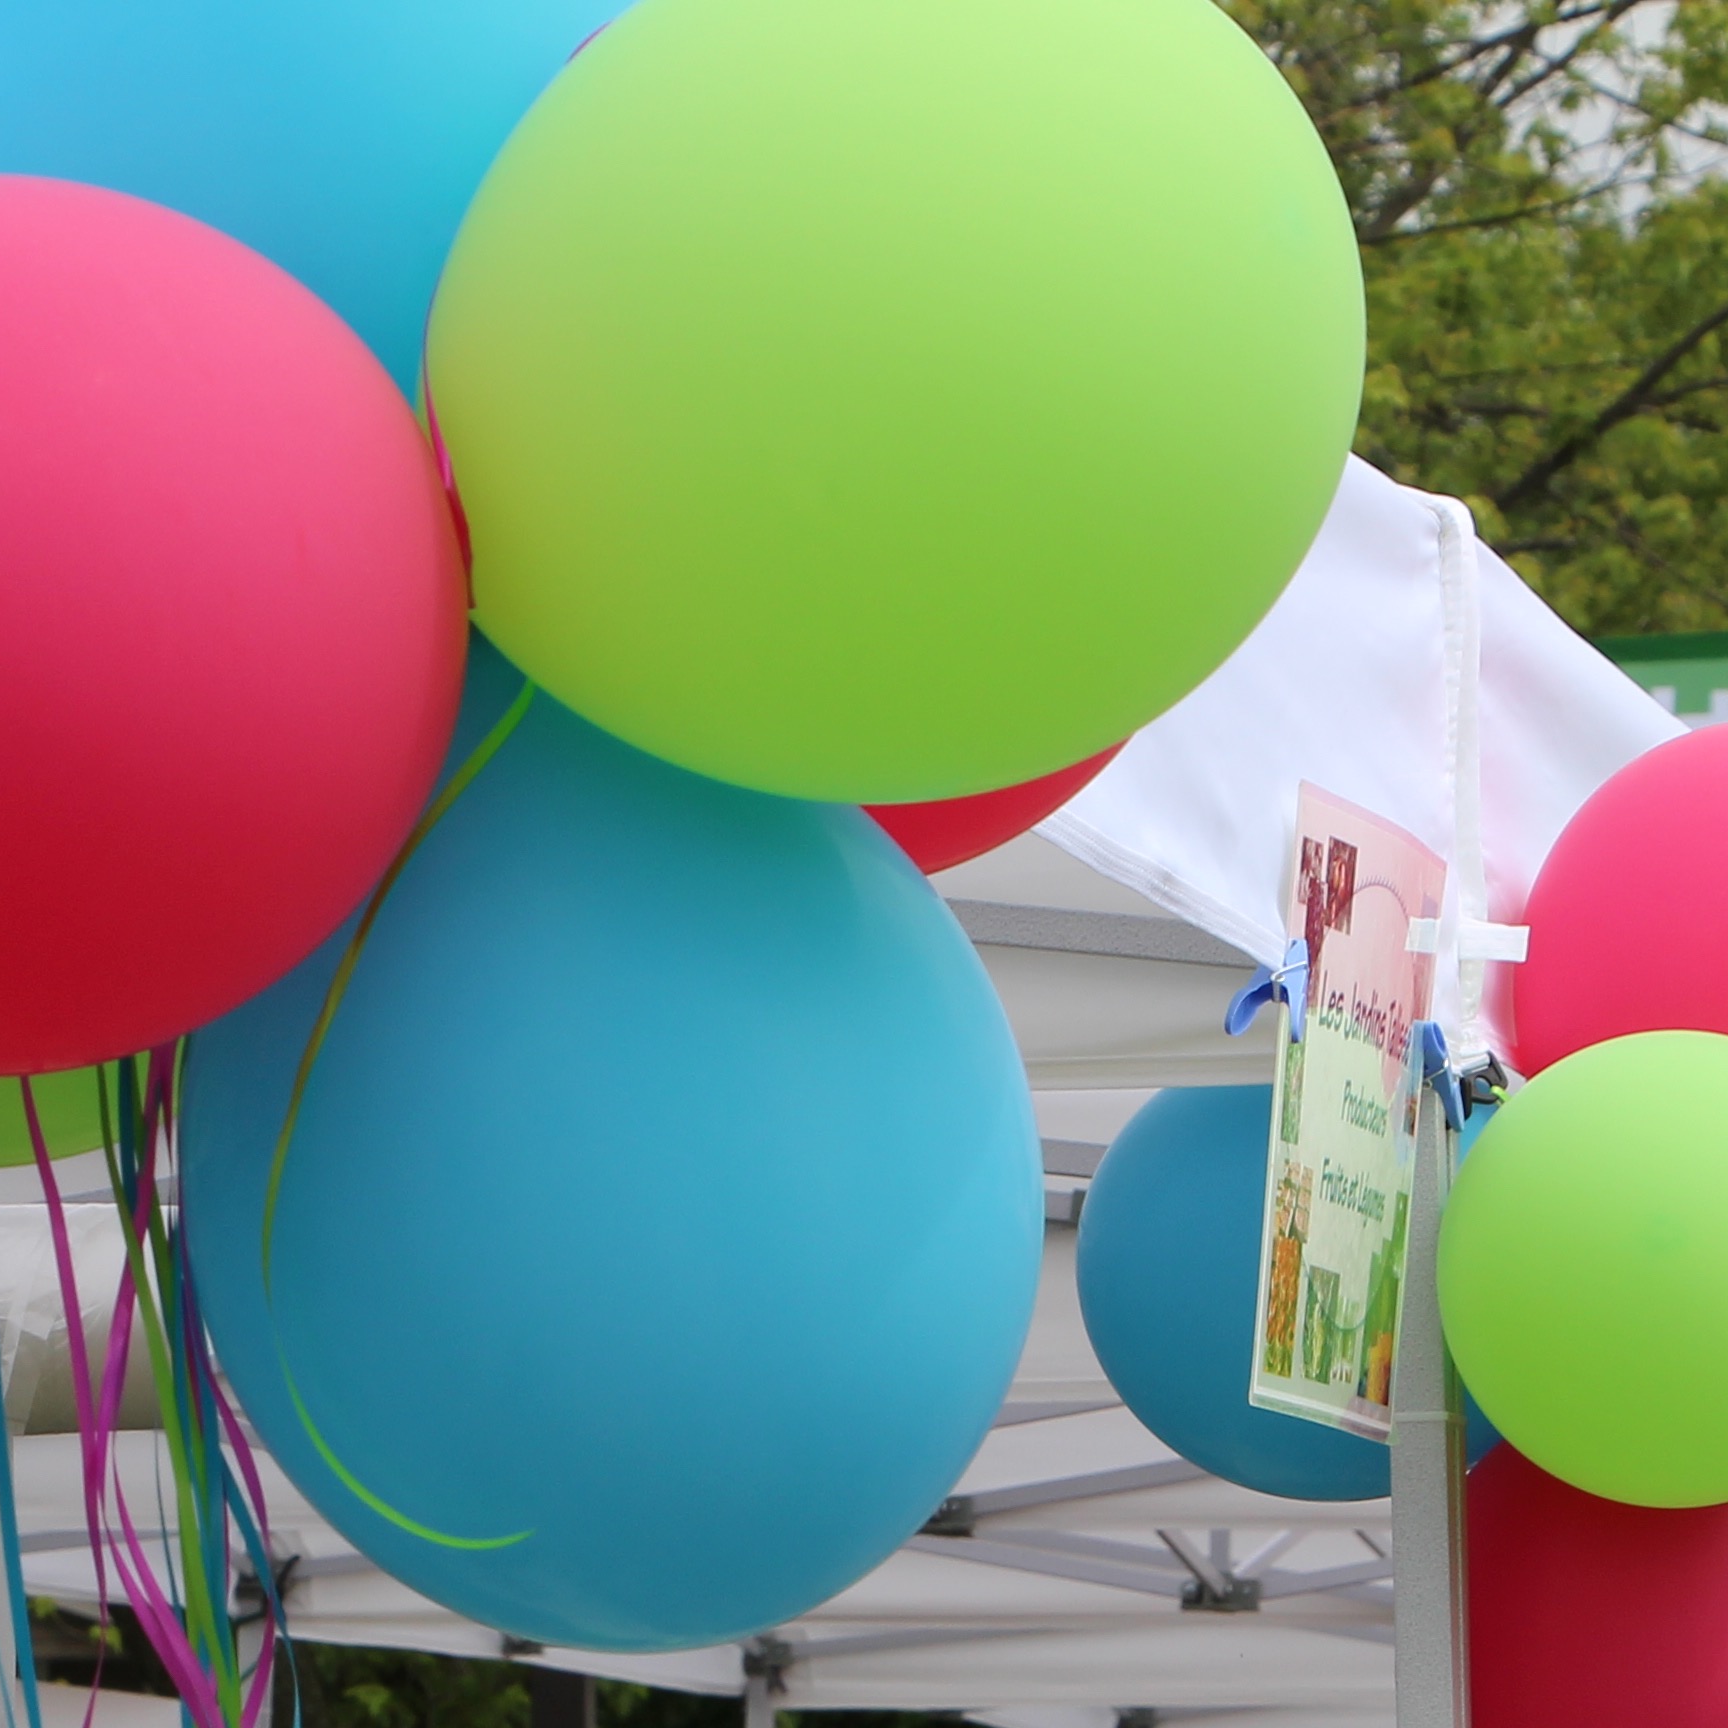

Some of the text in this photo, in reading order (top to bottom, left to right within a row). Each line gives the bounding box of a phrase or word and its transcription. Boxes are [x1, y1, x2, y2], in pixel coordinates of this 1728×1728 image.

[1319, 970, 1344, 1032] Les
[1344, 982, 1386, 1049] Jardins
[1341, 1080, 1388, 1138] Producteurs
[1319, 1157, 1386, 1228] Fruits et Légumes
